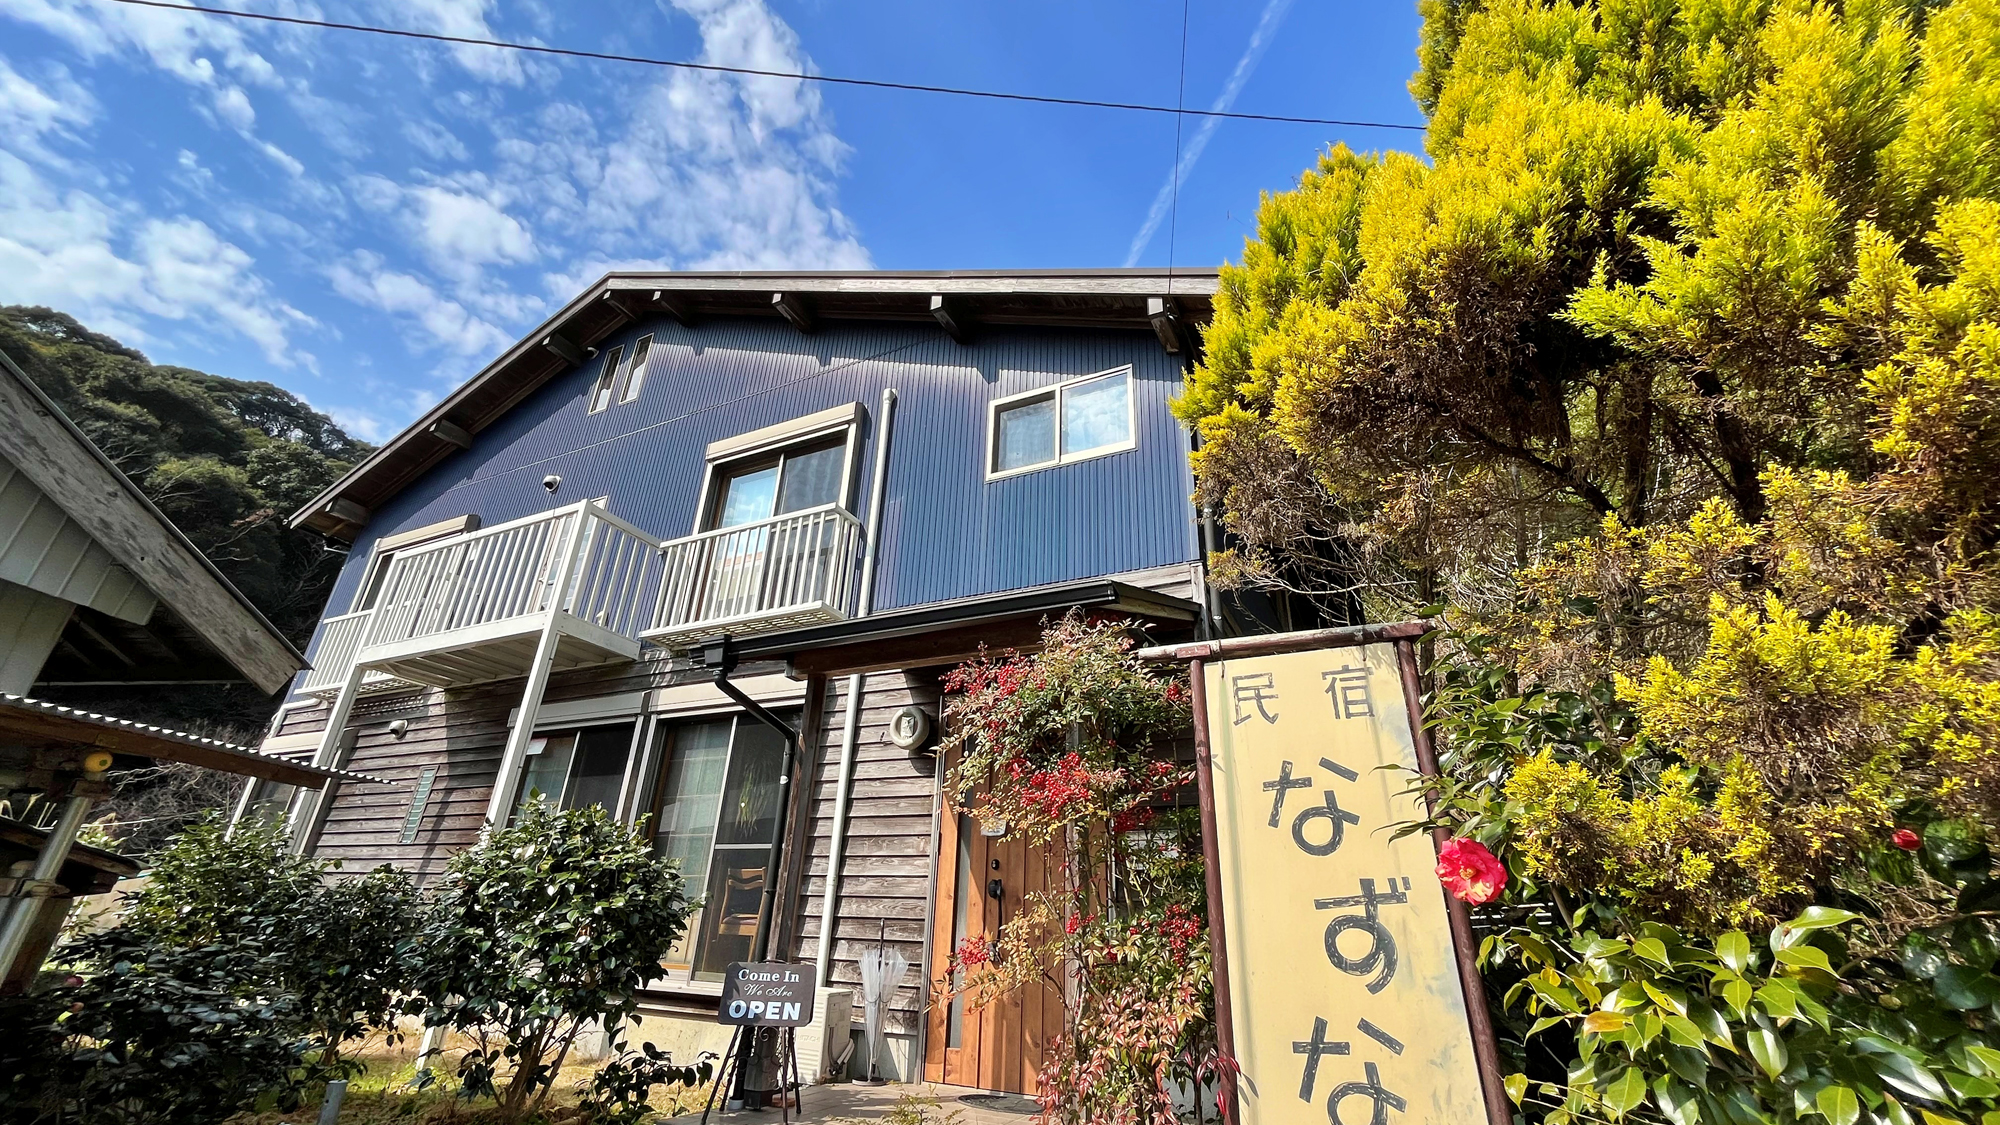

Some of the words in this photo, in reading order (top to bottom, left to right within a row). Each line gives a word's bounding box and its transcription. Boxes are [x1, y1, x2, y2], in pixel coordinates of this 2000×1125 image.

[1232, 665, 1375, 726] 民宿
[1263, 757, 1411, 1125] なずな
[738, 969, 780, 981] Come
[784, 970, 800, 983] In
[744, 983, 764, 996] We
[765, 985, 794, 997] Are
[728, 1000, 801, 1020] OPEN
